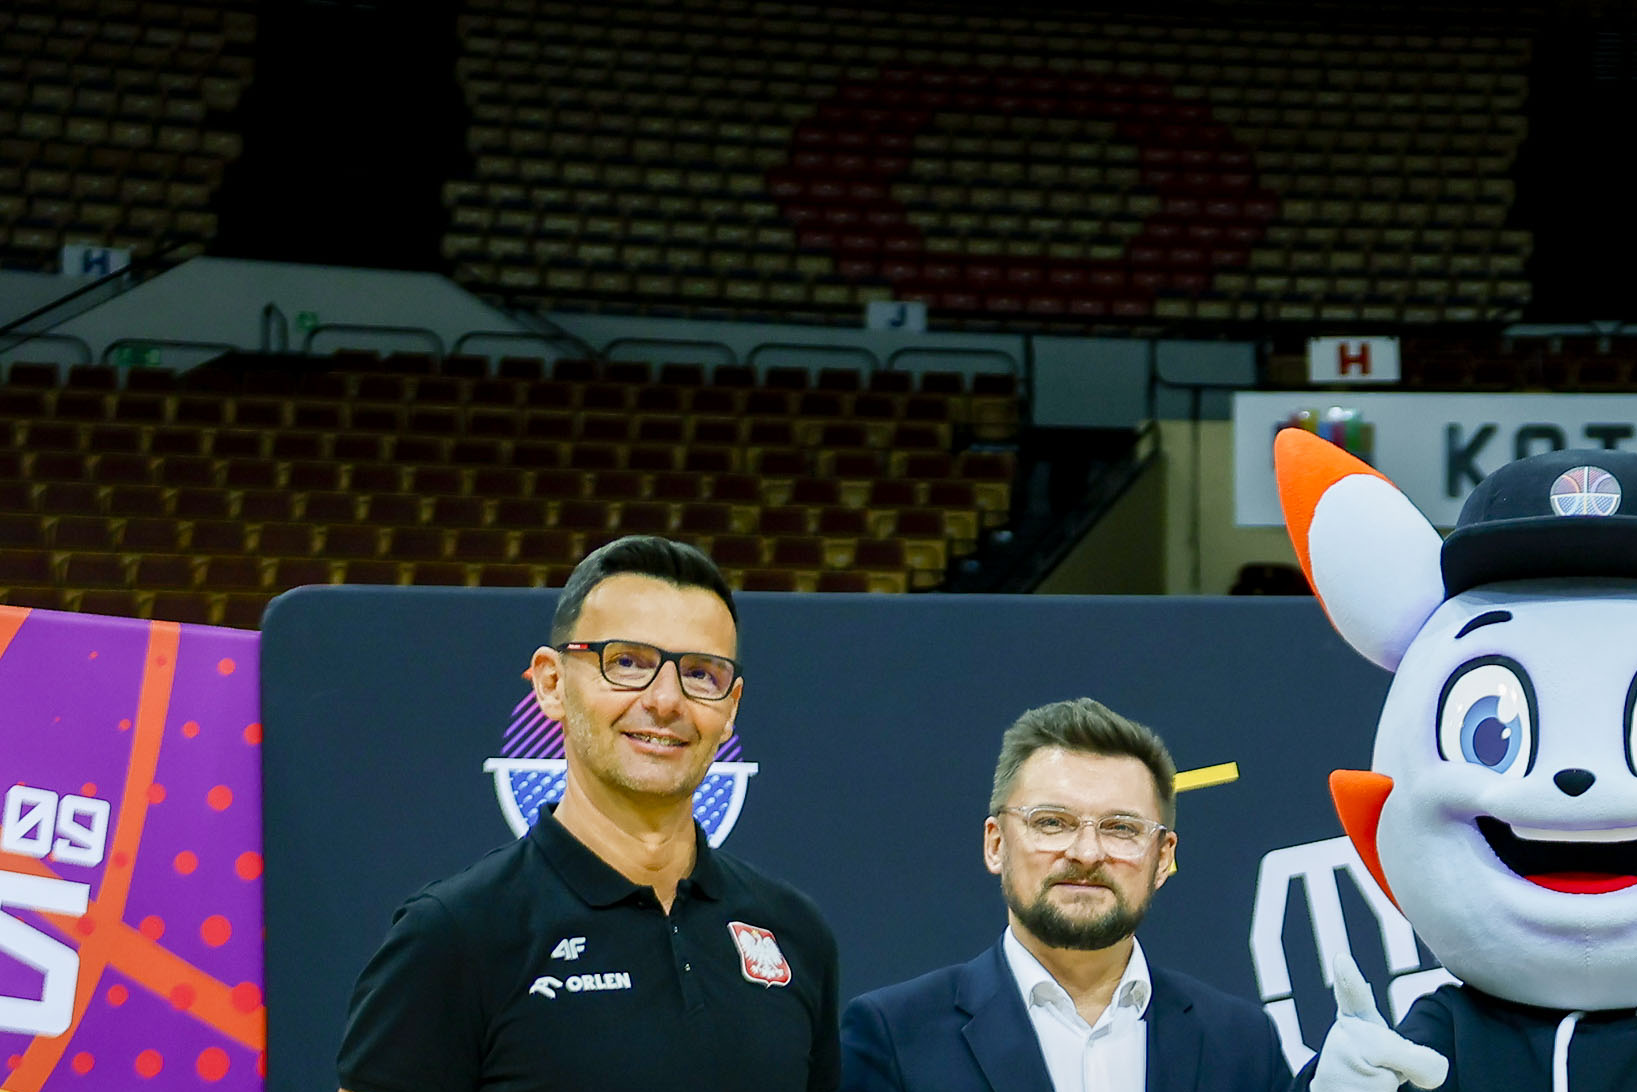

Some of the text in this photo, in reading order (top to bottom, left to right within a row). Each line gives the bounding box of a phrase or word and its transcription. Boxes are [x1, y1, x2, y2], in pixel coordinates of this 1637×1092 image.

[83, 247, 110, 274] H
[889, 303, 907, 327] J
[1338, 342, 1371, 376] H
[565, 972, 632, 993] ORLEN
